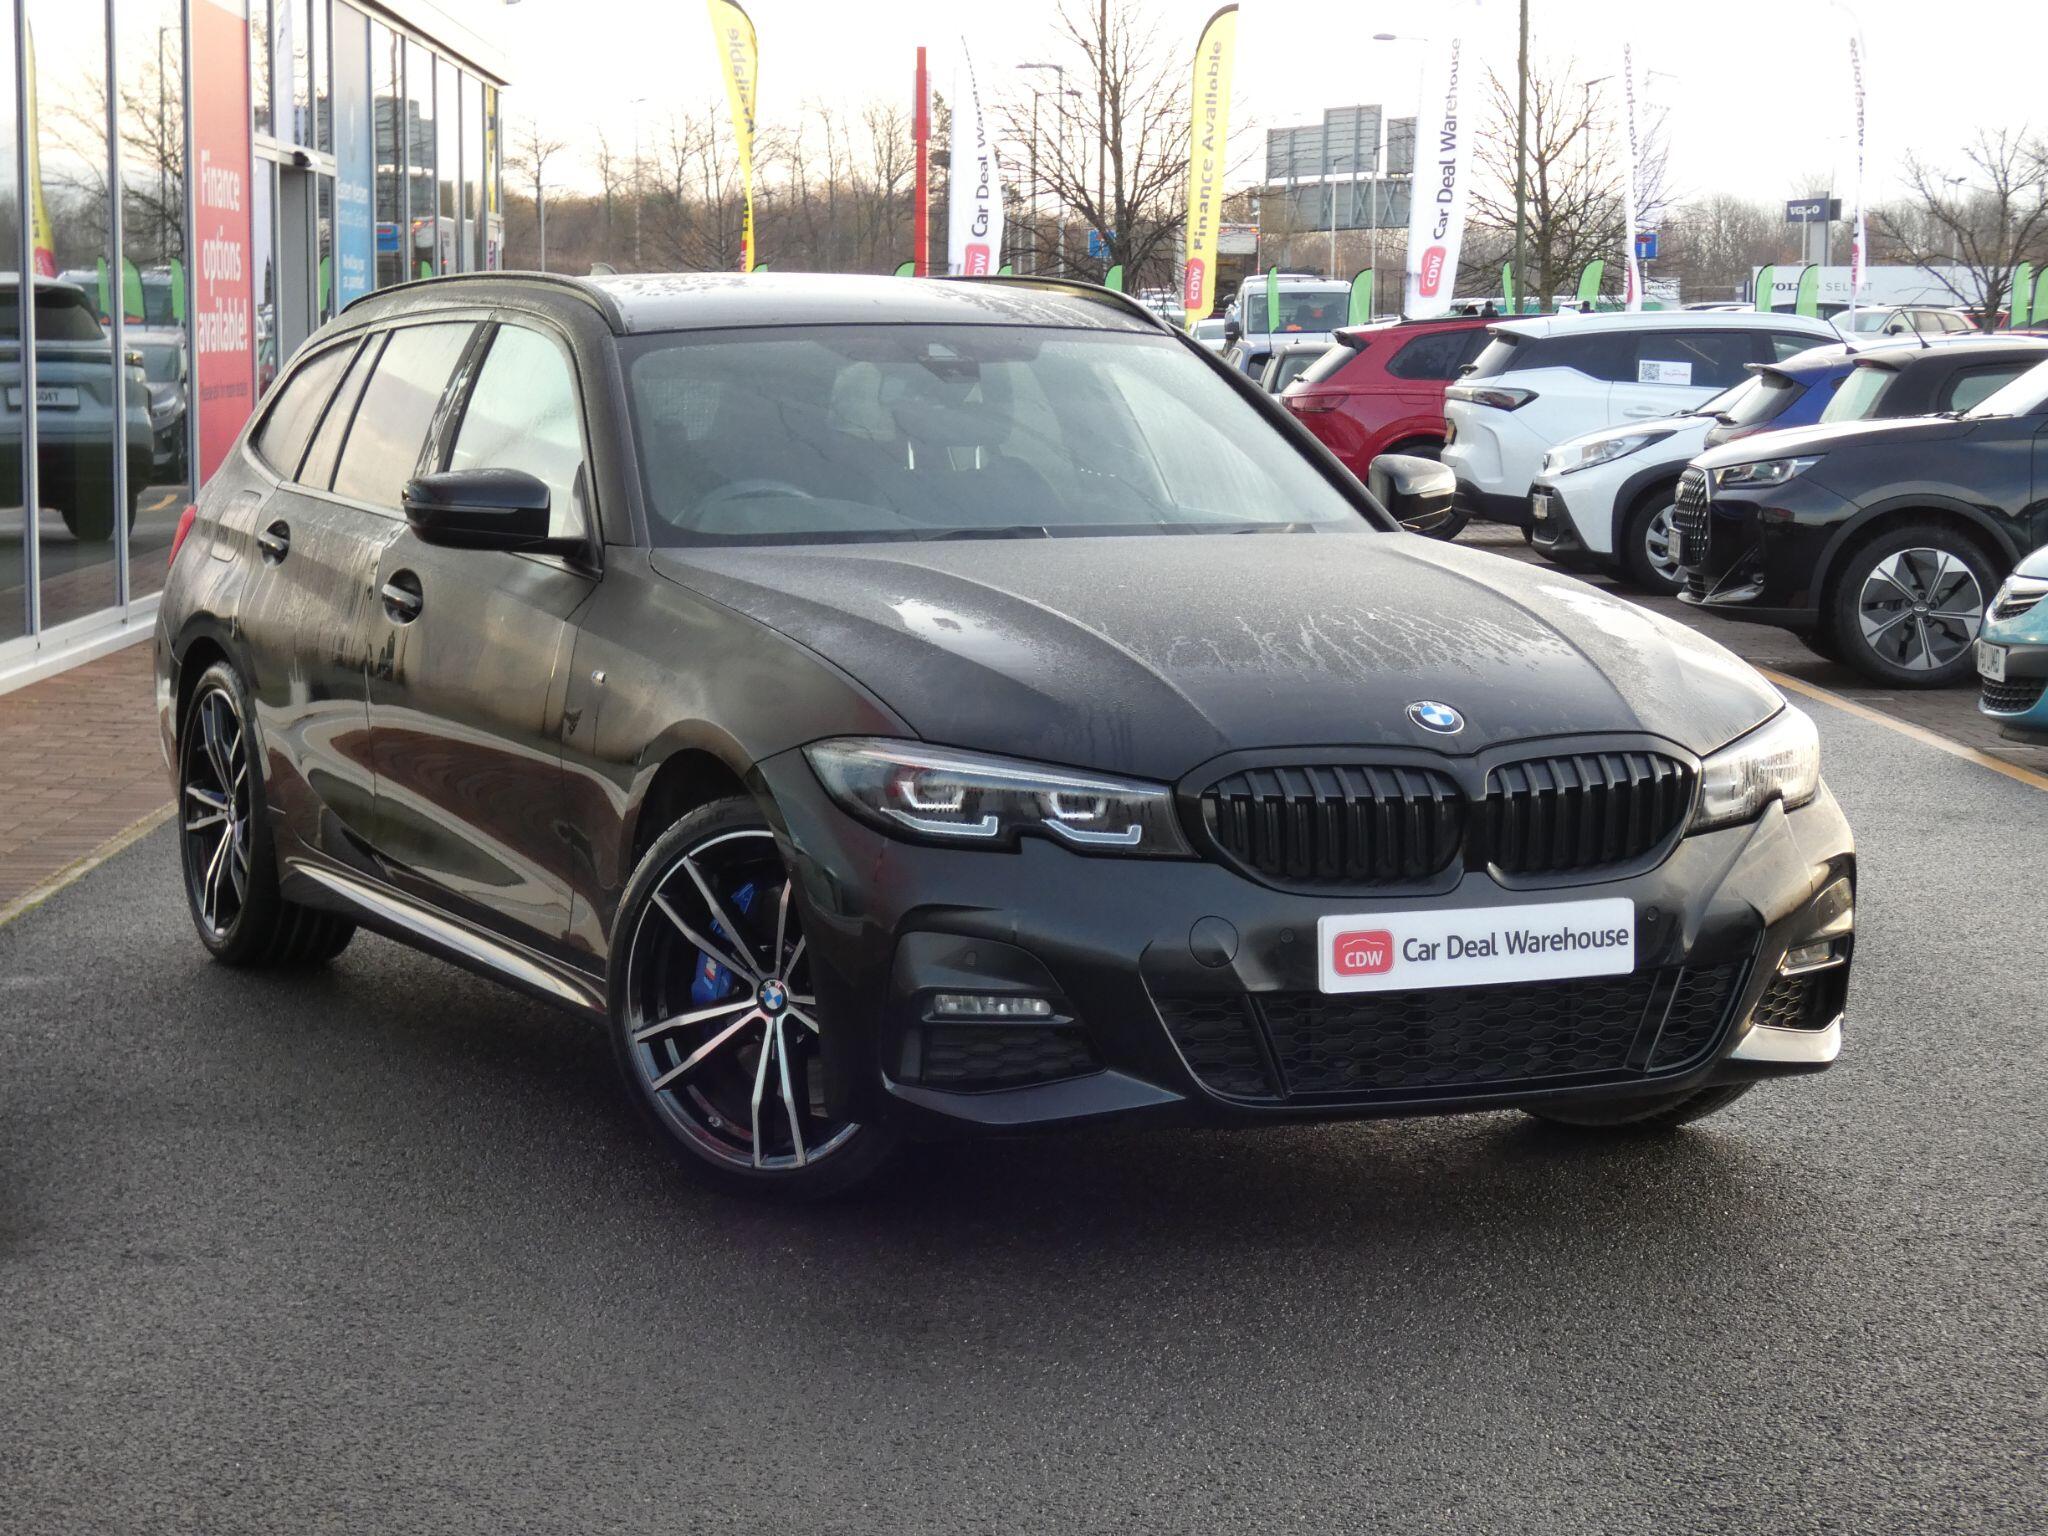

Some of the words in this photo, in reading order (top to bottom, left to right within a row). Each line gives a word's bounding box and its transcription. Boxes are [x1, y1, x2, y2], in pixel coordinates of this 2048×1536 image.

[1201, 40, 1222, 151] Available
[1440, 37, 1462, 153] Warehouse
[201, 150, 240, 212] Finance
[976, 156, 989, 199] Deal
[1436, 157, 1456, 203] Deal
[971, 206, 989, 238] Car
[1193, 158, 1213, 250] Finance
[1433, 208, 1450, 240] Car
[203, 225, 241, 296] options
[974, 253, 987, 275] DW
[1427, 255, 1442, 286] CDW
[1190, 267, 1201, 300] CDW
[199, 298, 248, 353] available!
[1345, 950, 1383, 968] CDW
[1403, 937, 1440, 962] Car
[1447, 932, 1499, 960] Deal
[1504, 927, 1629, 955] Warehouse
